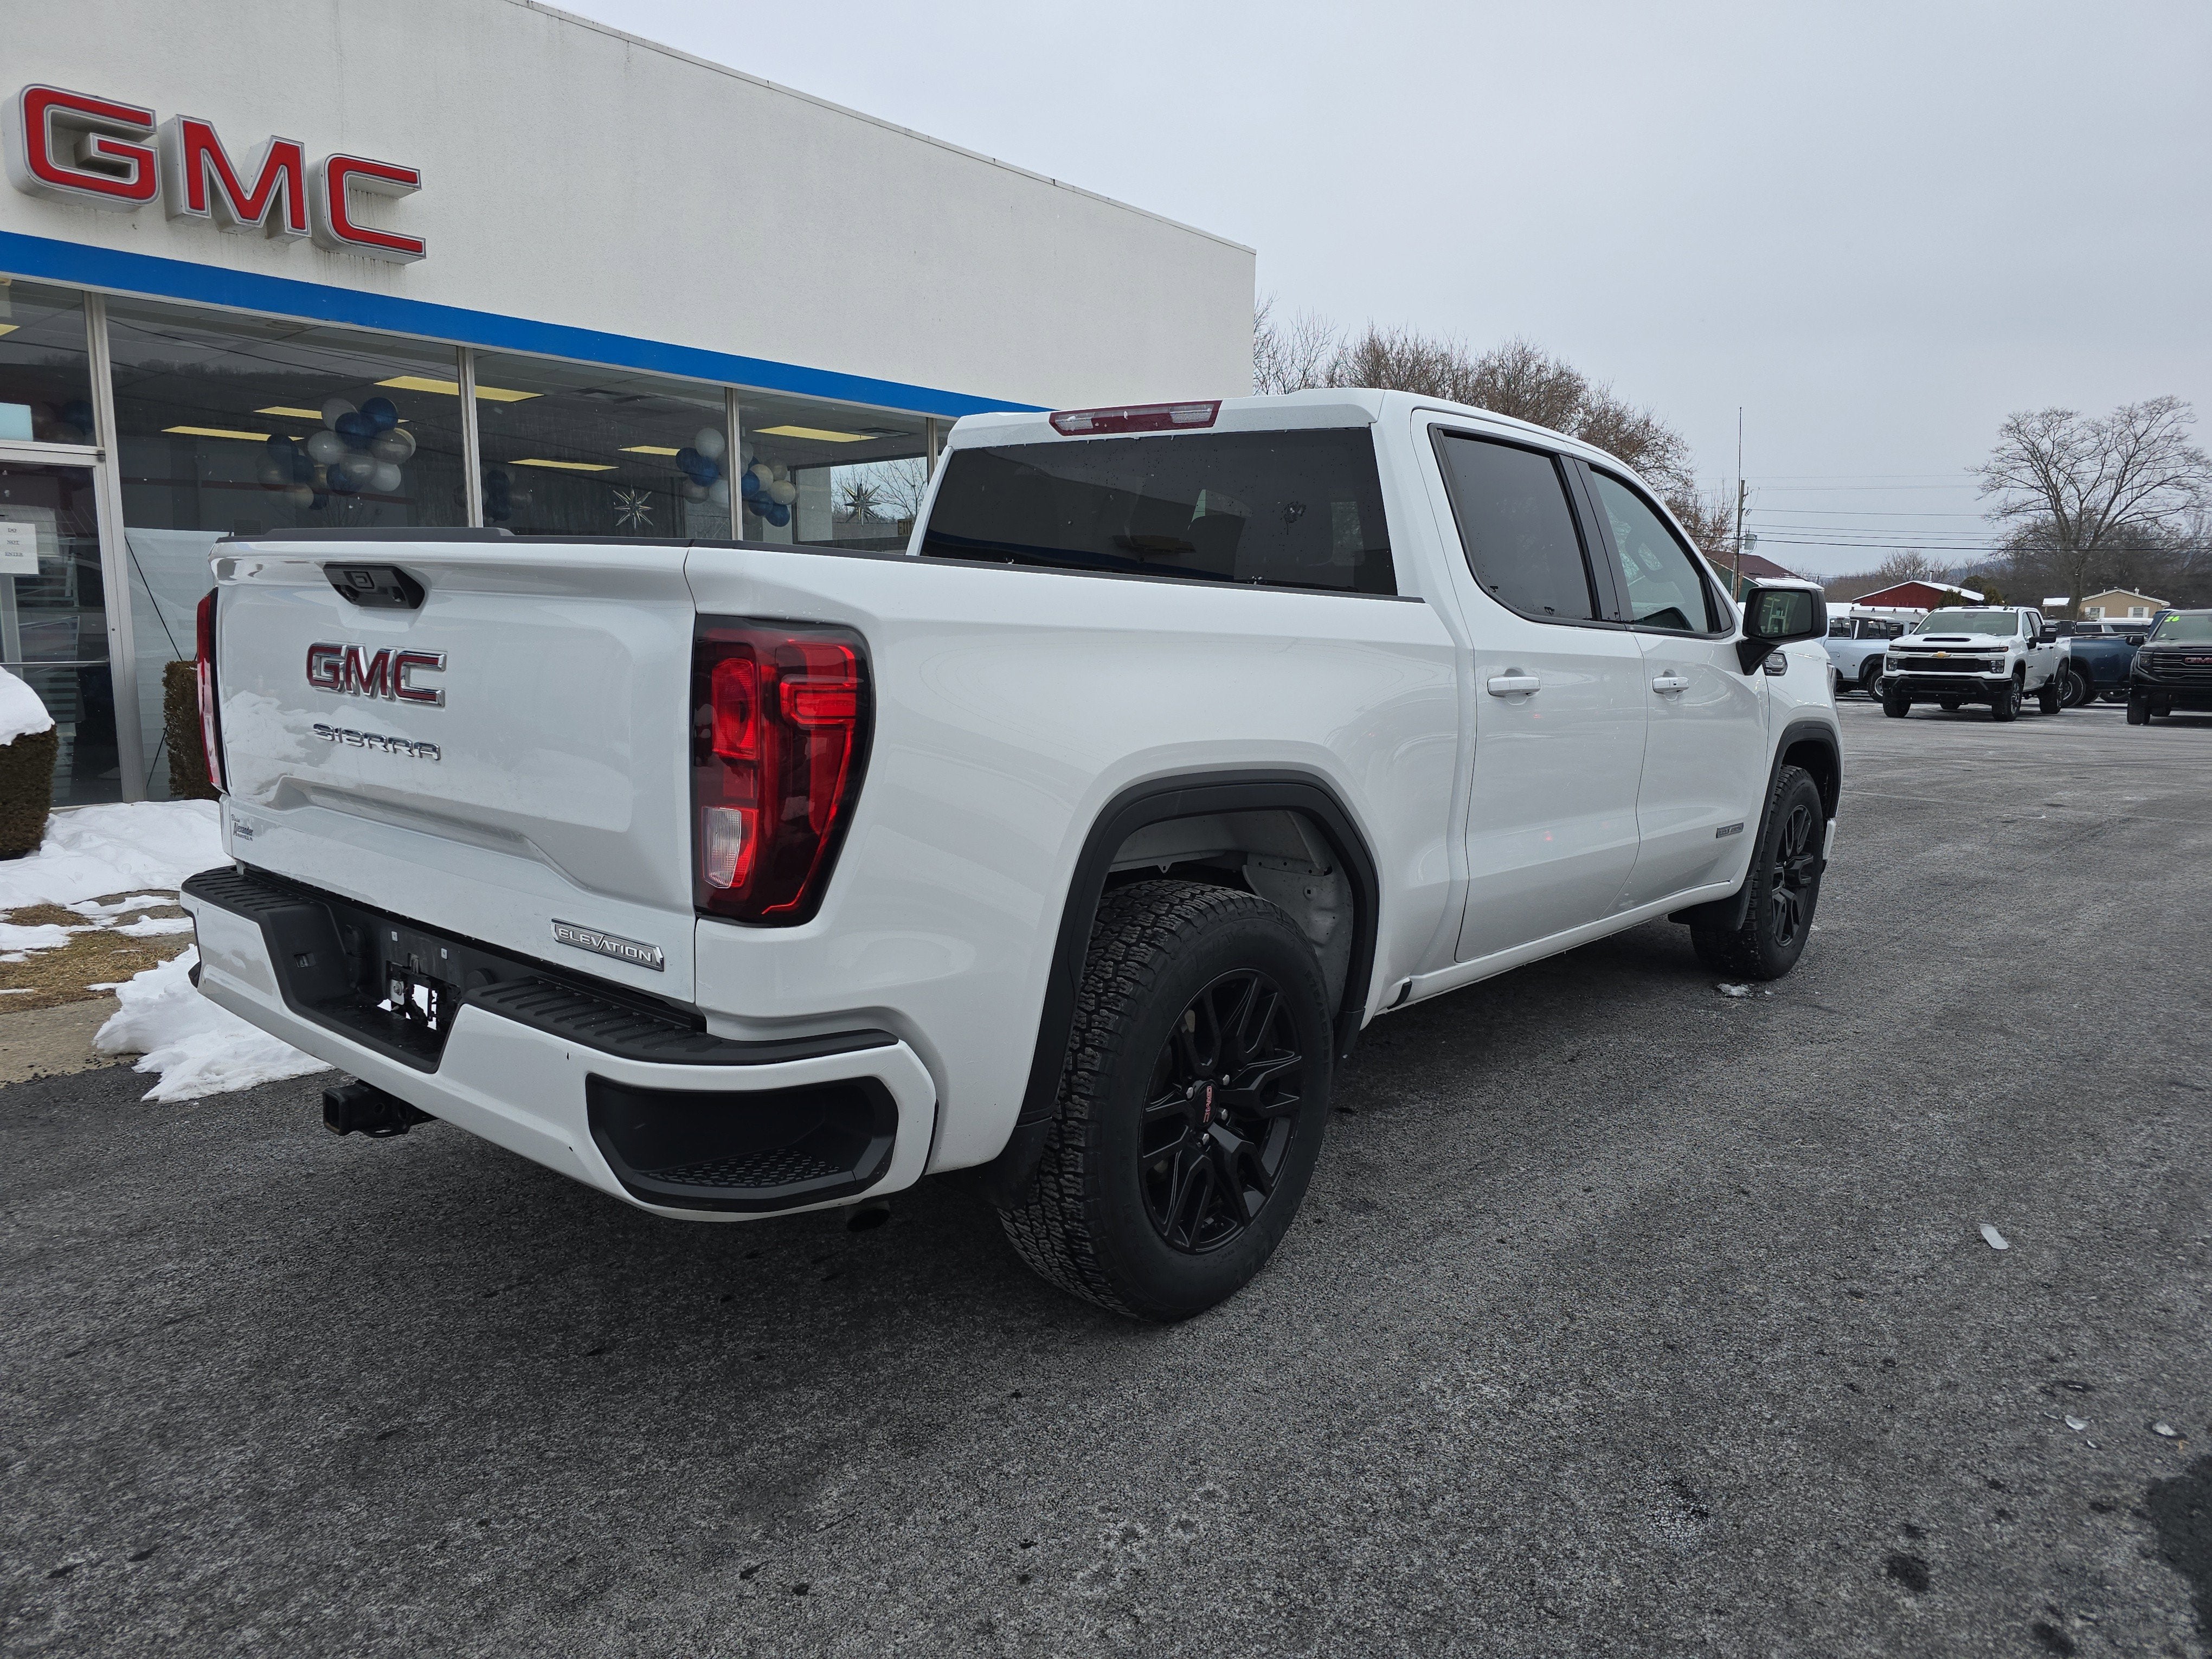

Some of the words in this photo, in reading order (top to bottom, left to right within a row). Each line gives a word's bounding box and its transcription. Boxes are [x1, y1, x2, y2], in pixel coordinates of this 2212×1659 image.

[17, 83, 427, 261] GMC
[898, 520, 912, 535] EXIT
[306, 643, 446, 708] GMC
[313, 723, 441, 761] SIERRA
[558, 928, 651, 962] ELEVATION
[1203, 1085, 1213, 1123] GMC
